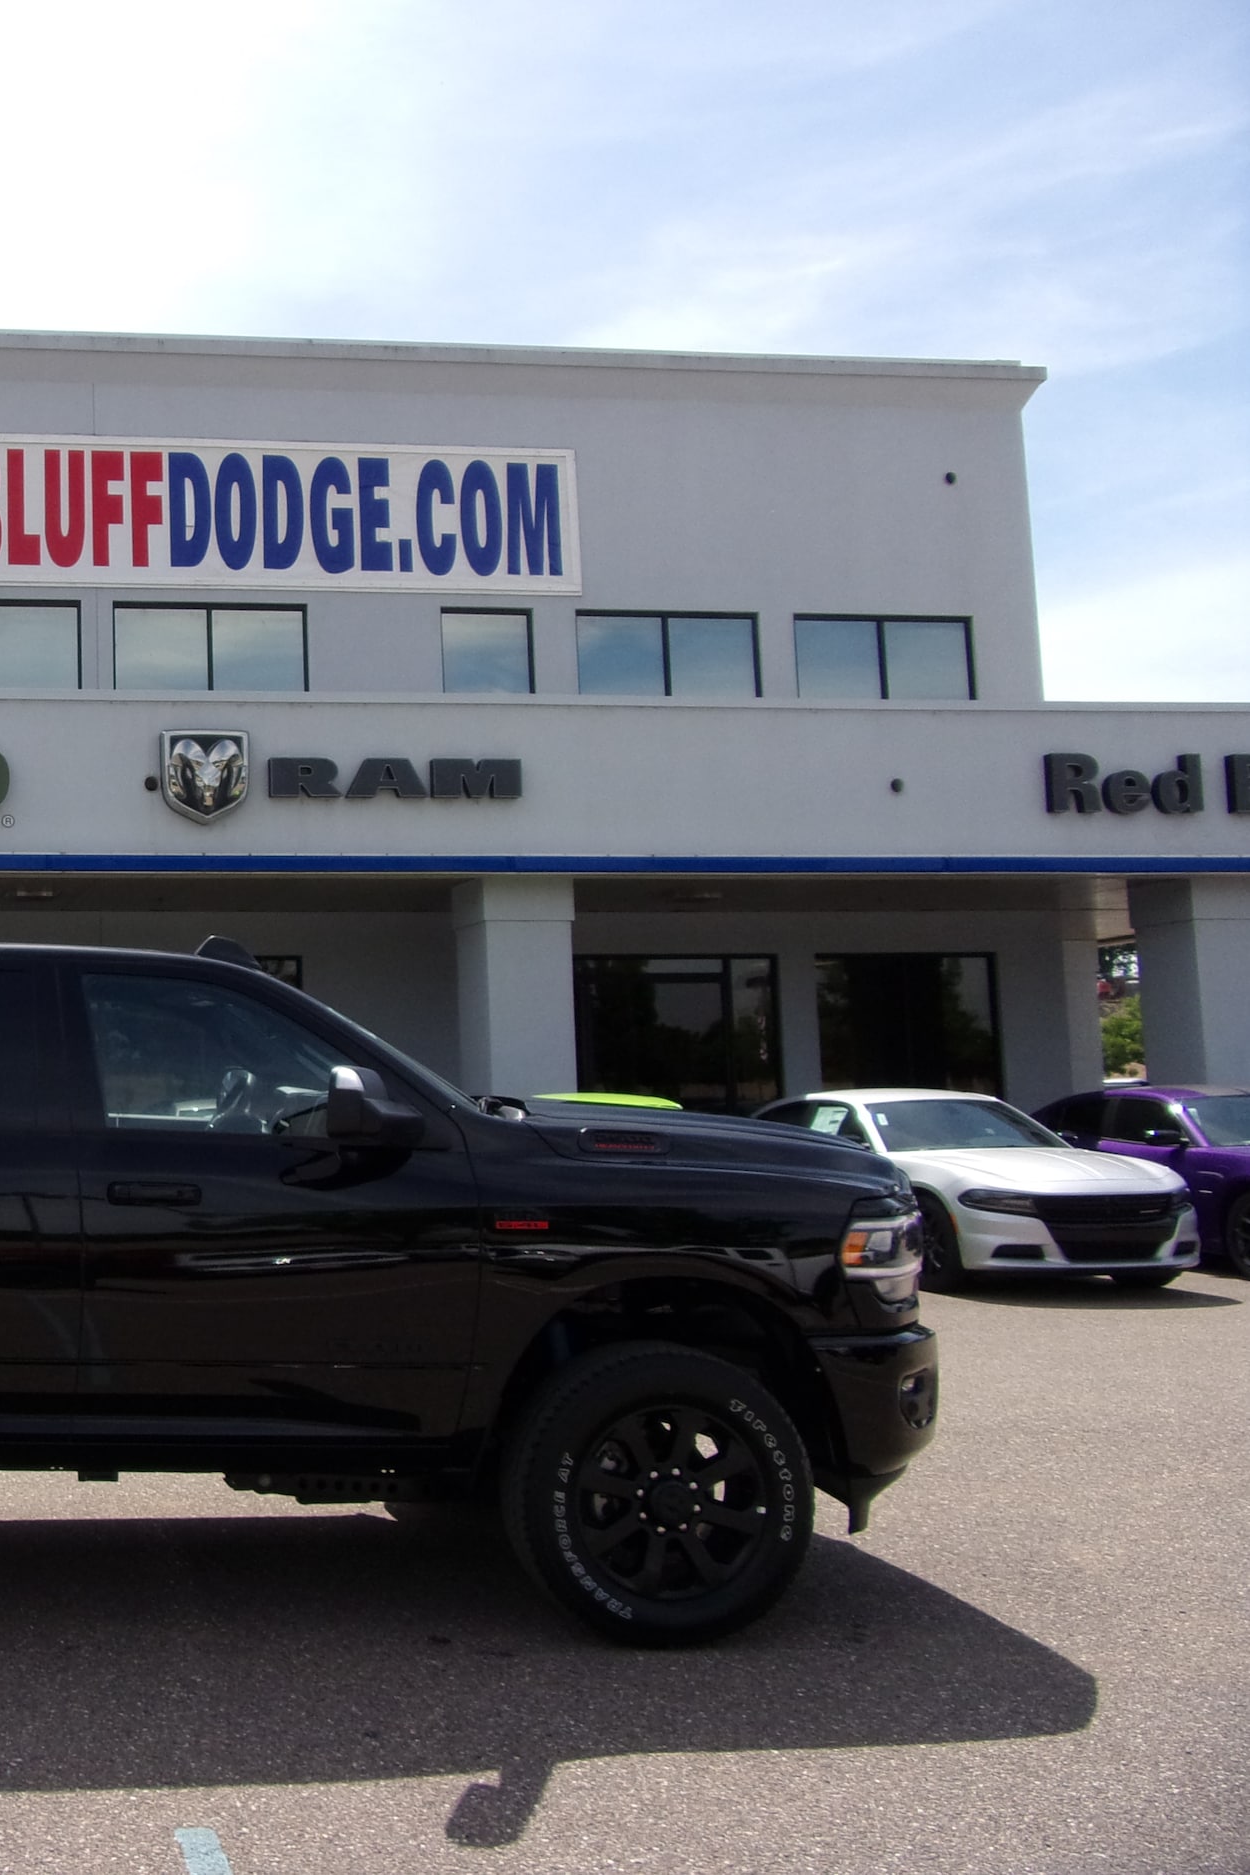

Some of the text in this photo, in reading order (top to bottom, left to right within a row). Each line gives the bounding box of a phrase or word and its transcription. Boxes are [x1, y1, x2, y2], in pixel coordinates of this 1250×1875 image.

[268, 757, 522, 799] RAM
[1043, 752, 1204, 814] Red
[554, 1491, 633, 1620] TRANSFORCE
